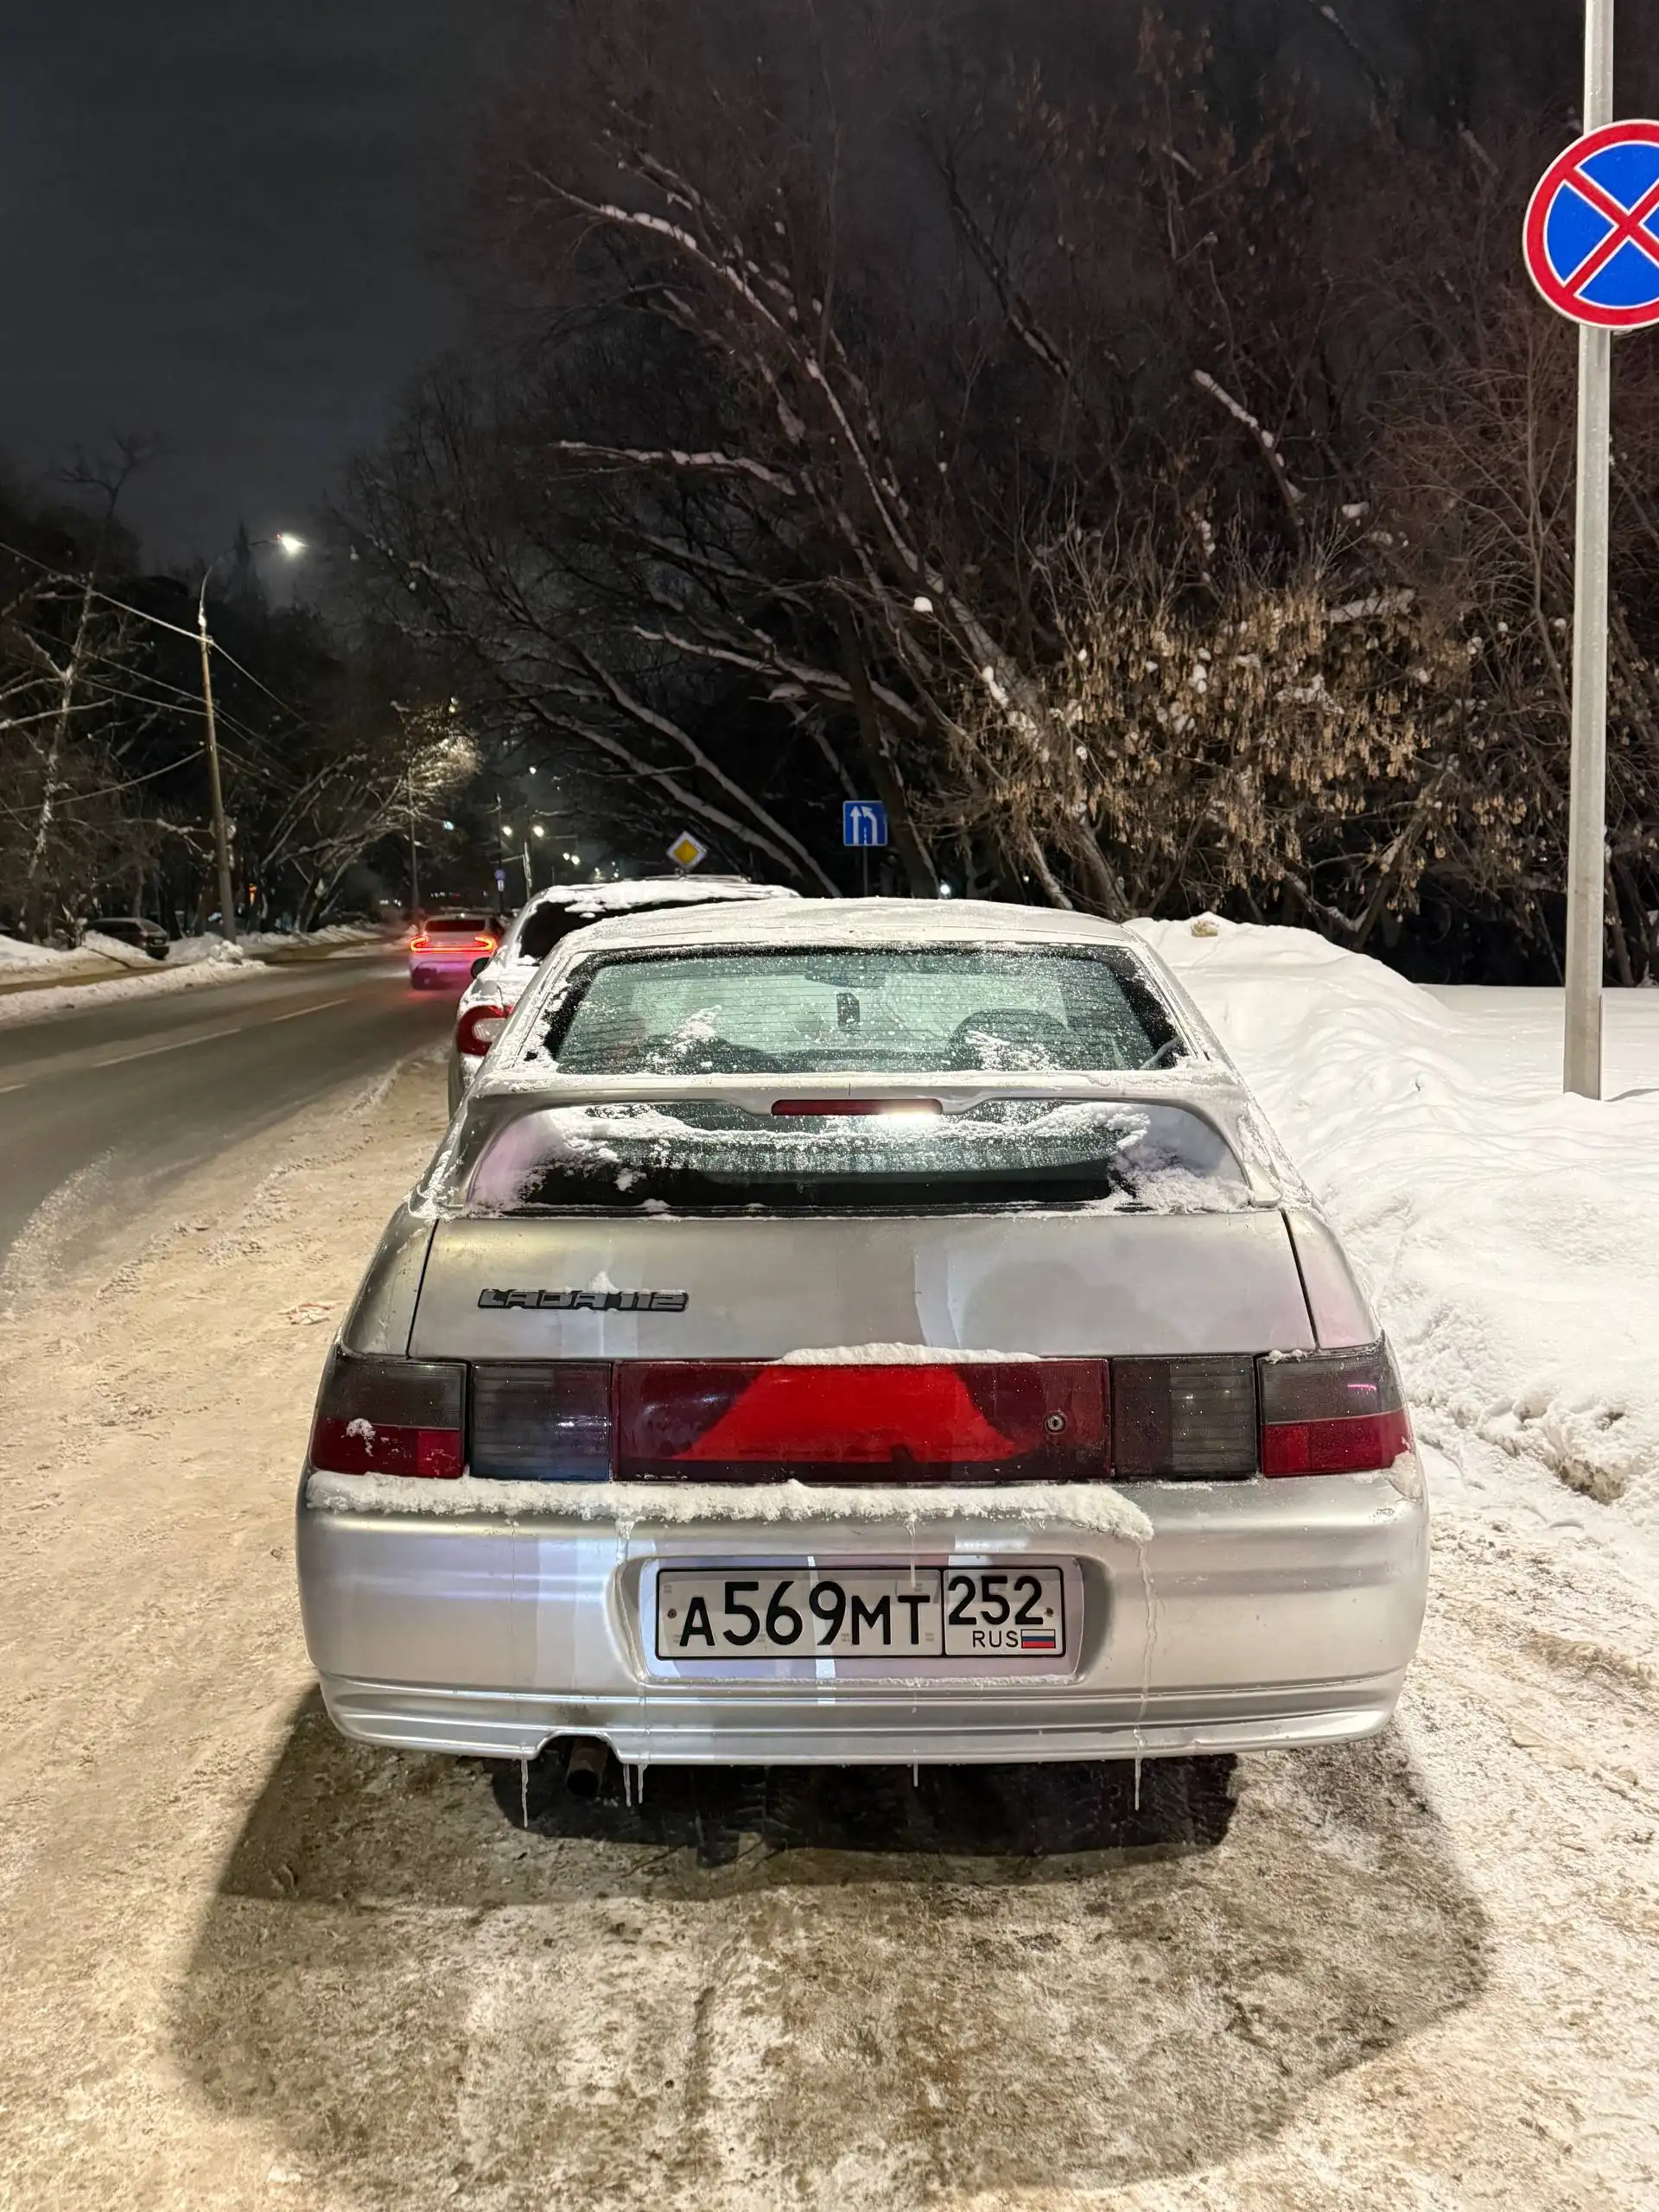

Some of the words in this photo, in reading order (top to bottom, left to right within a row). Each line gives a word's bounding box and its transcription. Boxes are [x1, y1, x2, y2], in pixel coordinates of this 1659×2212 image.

[479, 1288, 608, 1311] LADA
[620, 1289, 689, 1312] 112
[948, 1575, 1044, 1625] 252
[972, 1630, 1019, 1648] RUS
